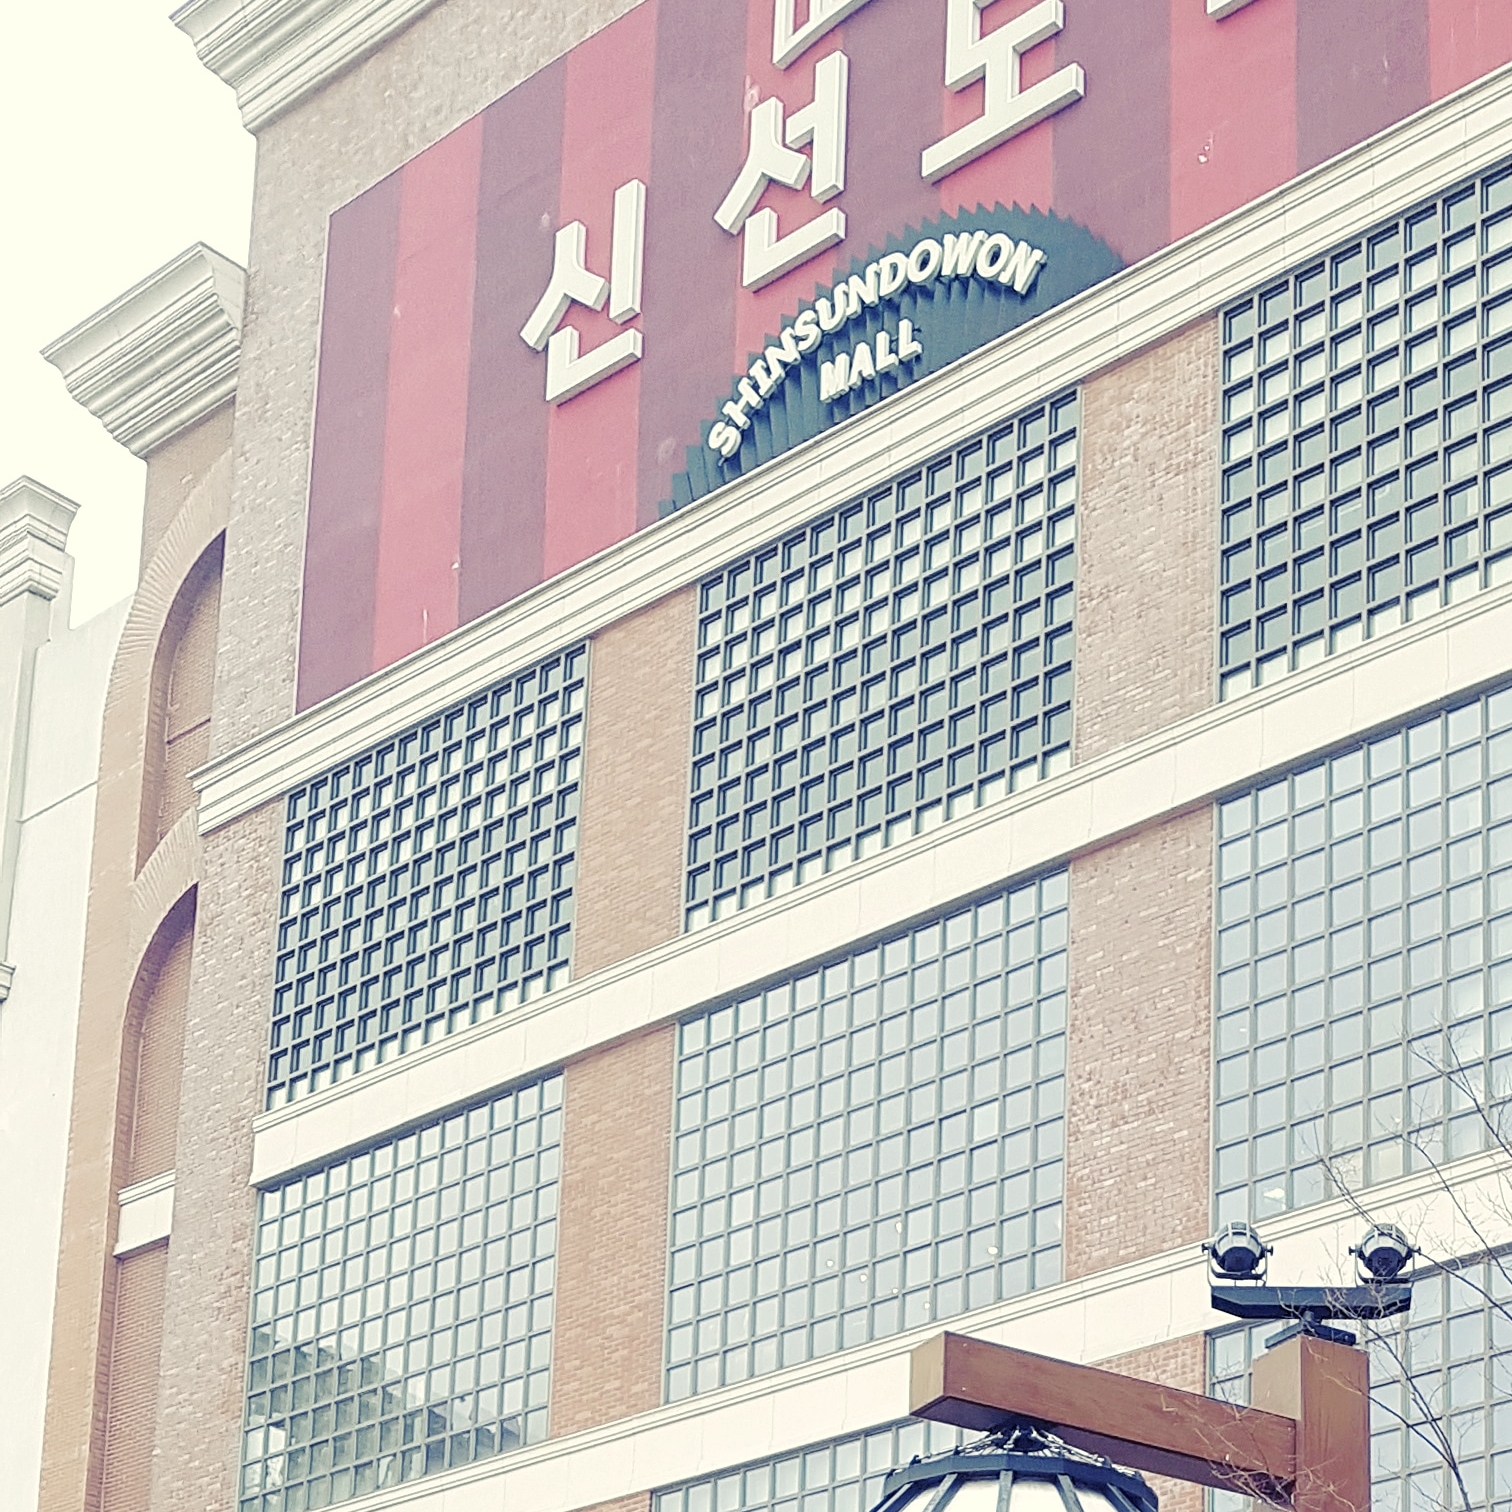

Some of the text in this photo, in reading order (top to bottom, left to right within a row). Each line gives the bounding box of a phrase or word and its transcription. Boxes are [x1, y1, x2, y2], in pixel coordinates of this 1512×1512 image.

[519, 0, 1262, 406] 신선도
[708, 230, 1047, 460] SHINSUNDOWON
[819, 319, 923, 402] MALL
